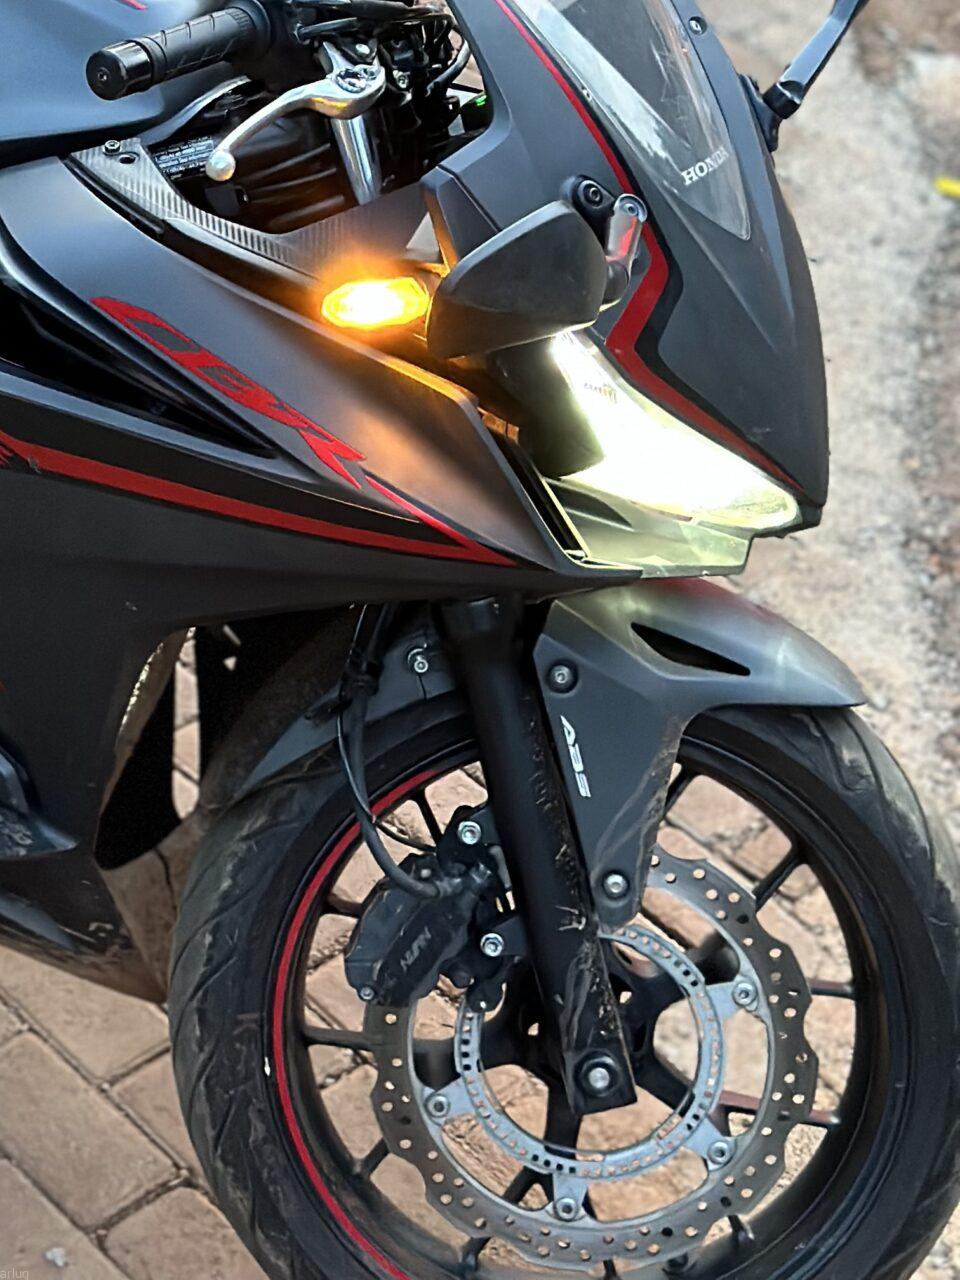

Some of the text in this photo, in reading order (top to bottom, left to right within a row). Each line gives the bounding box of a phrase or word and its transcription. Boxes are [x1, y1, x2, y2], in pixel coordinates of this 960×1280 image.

[681, 146, 729, 185] HONDA
[90, 296, 366, 488] CBR
[560, 715, 591, 797] ABS
